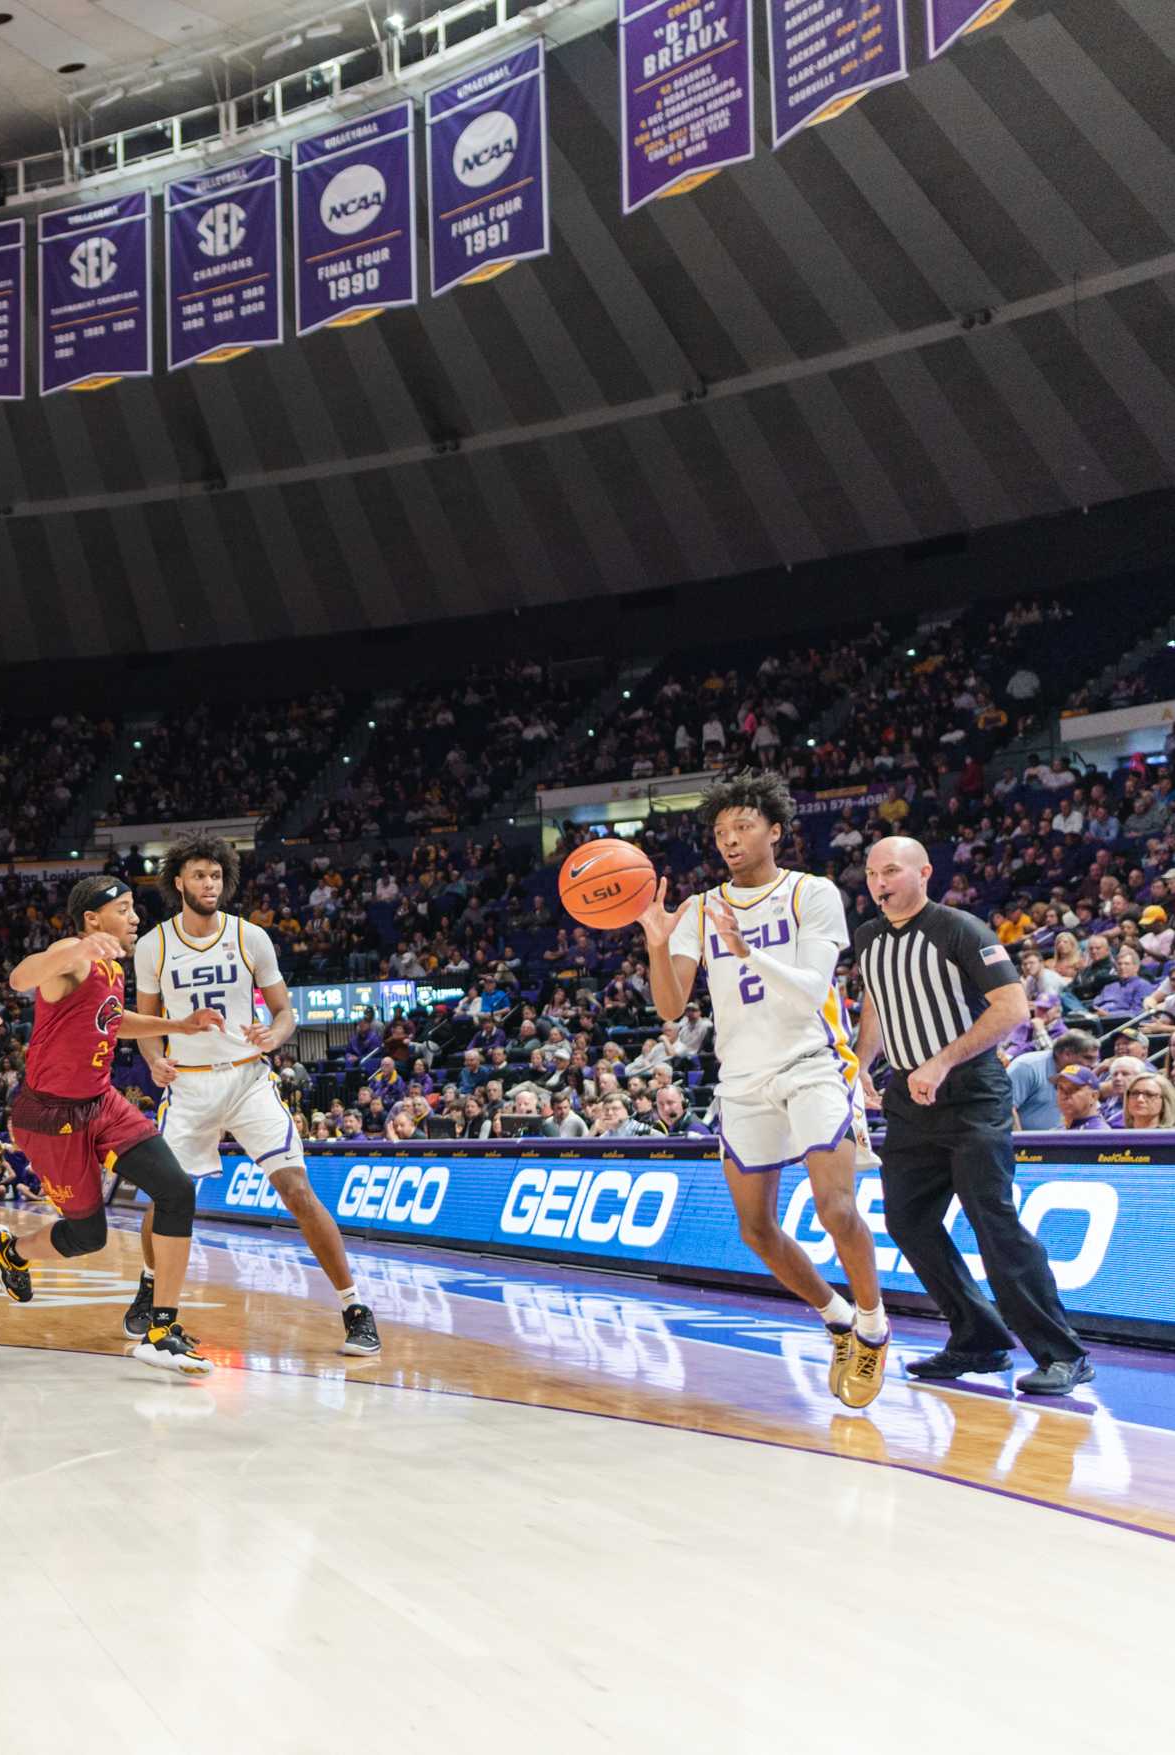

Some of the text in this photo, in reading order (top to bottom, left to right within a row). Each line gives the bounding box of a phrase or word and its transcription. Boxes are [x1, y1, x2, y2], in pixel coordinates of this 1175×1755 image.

[643, 17, 728, 78] BREAUX
[461, 138, 514, 175] NCAA
[328, 192, 384, 222] NCAA
[451, 196, 522, 238] FINAL FOUR
[197, 202, 246, 256] SEC
[464, 220, 509, 257] 1991
[69, 236, 118, 289] SEC
[193, 256, 254, 282] CHAMPIONS
[318, 247, 391, 281] FINAL FOUR
[328, 268, 380, 301] 1990
[582, 882, 621, 904] LSU
[171, 964, 237, 989] LSU
[190, 990, 226, 1020] 15
[92, 1041, 108, 1067] 2
[226, 1162, 288, 1210] GEIC
[337, 1165, 450, 1225] GEICO
[500, 1168, 680, 1247] GEICO
